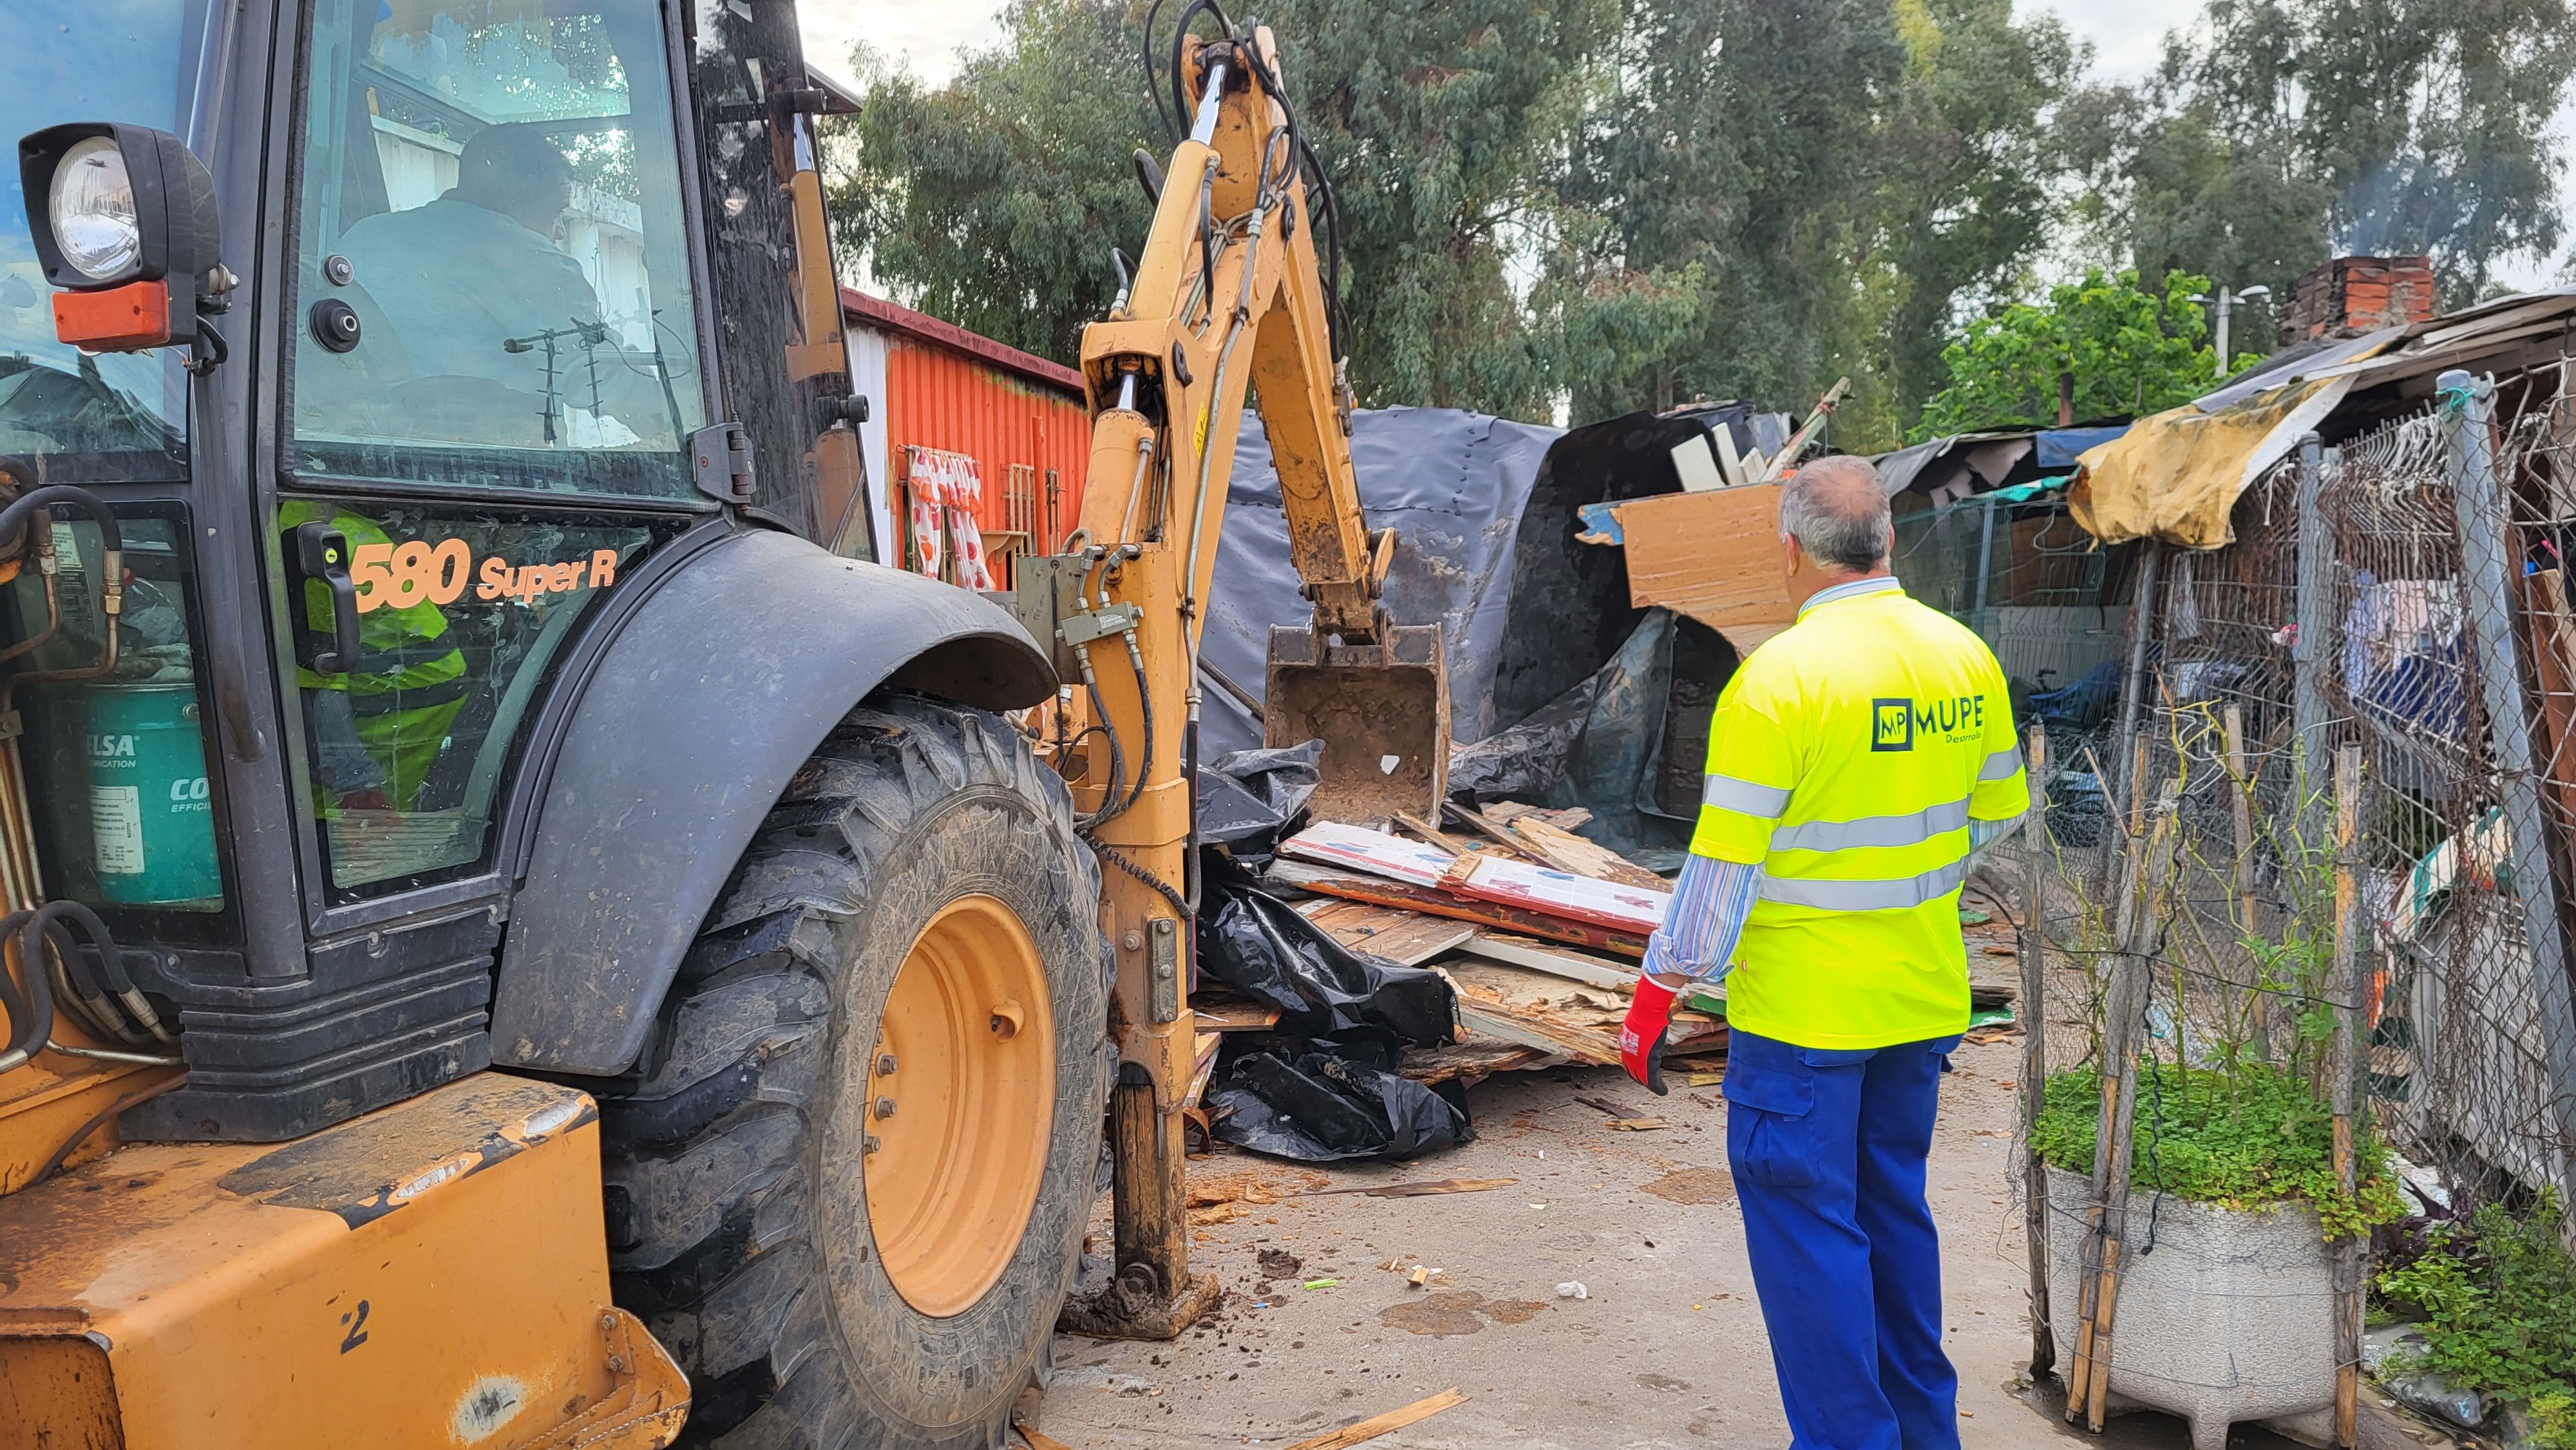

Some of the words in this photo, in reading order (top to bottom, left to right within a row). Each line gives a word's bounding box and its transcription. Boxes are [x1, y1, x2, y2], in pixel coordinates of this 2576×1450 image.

[349, 538, 471, 613] 580
[477, 557, 587, 603] Super
[589, 549, 618, 588] R
[1915, 695, 1984, 737] MUPE
[340, 1299, 370, 1355] 2
